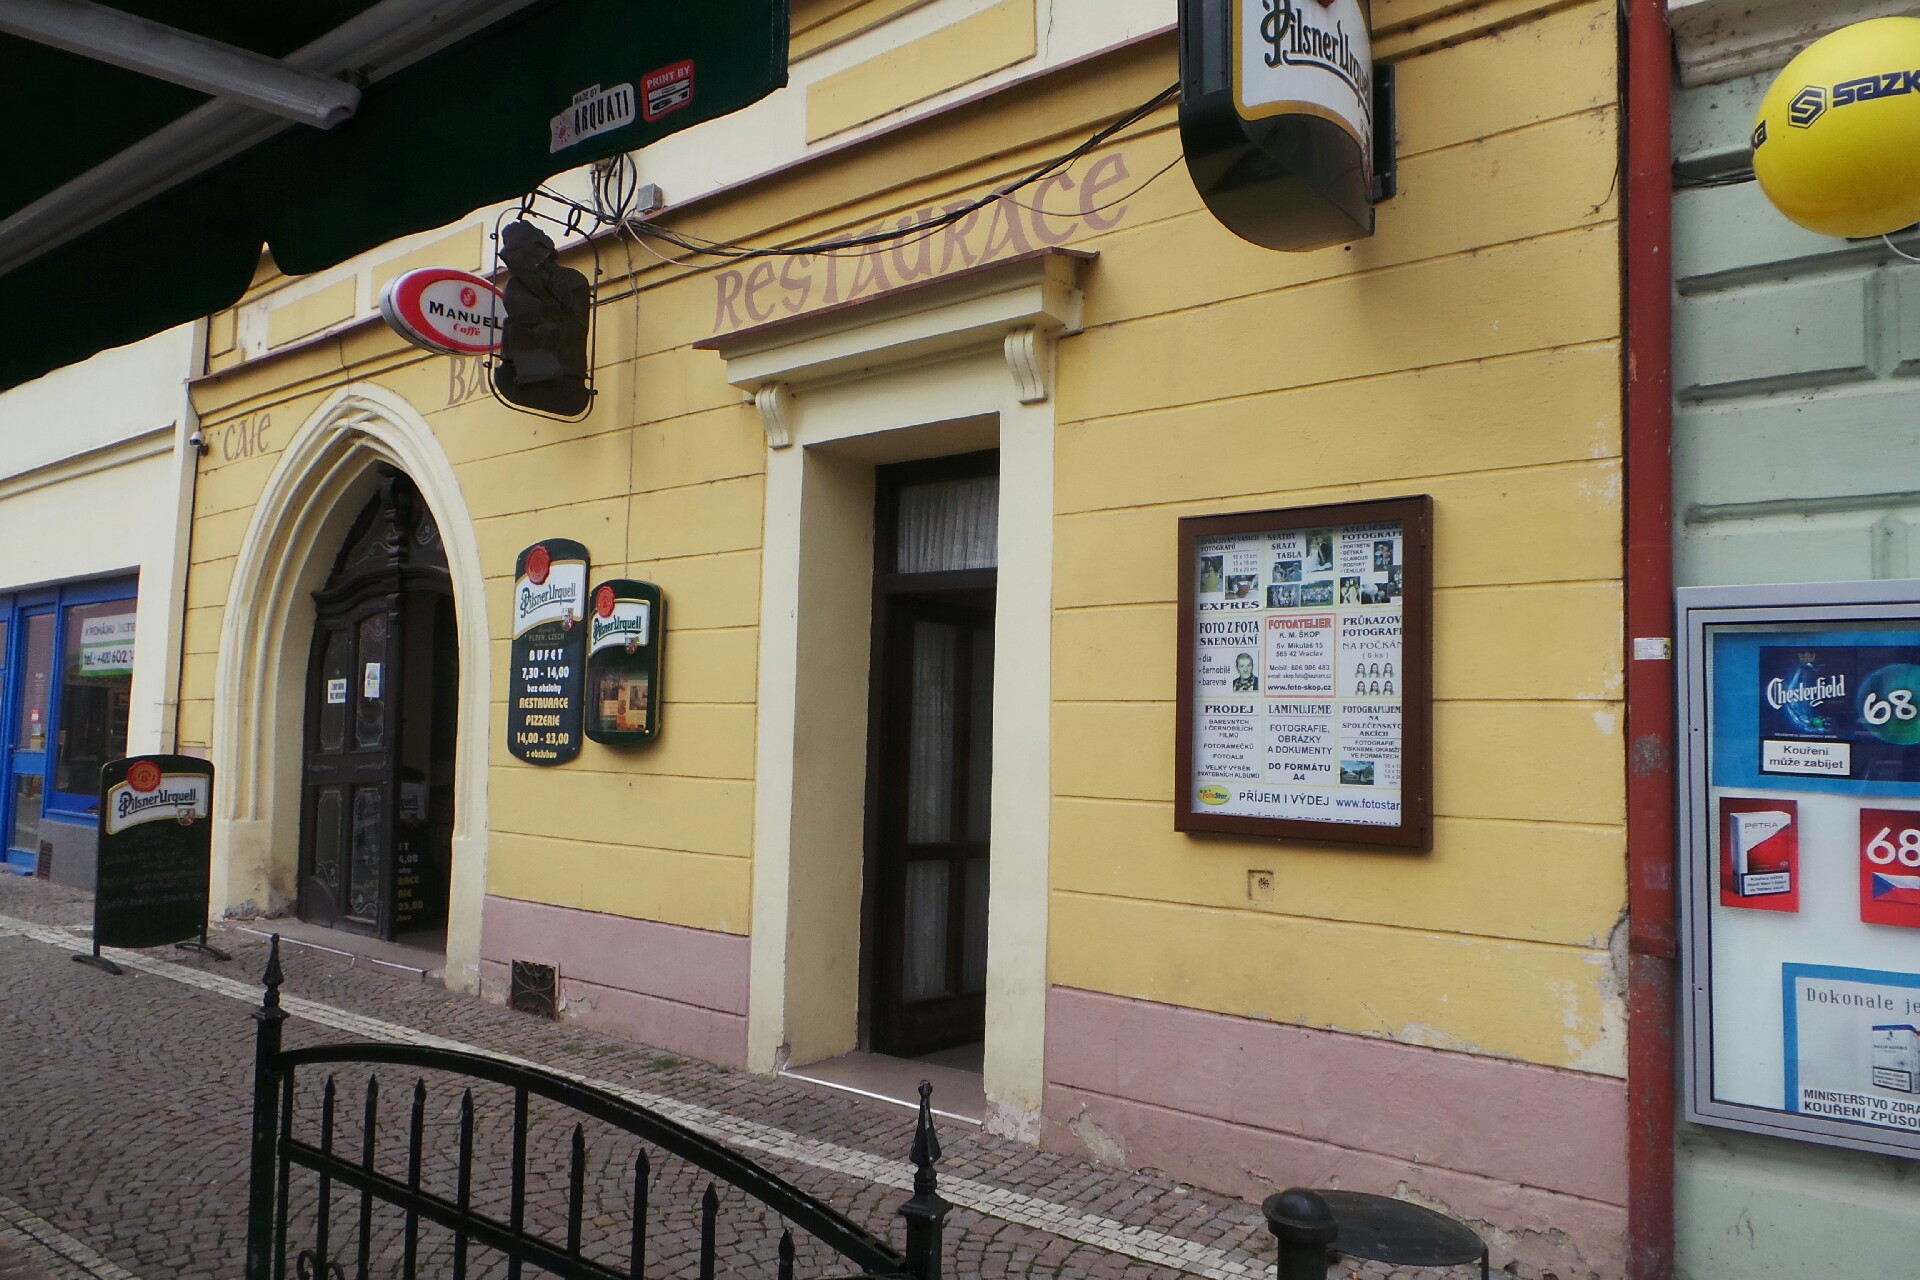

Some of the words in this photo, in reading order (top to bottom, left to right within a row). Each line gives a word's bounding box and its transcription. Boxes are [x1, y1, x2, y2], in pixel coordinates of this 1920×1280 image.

[646, 71, 675, 88] PRINT
[677, 66, 690, 77] BY
[574, 90, 630, 136] ARQUATI
[1271, 542, 1297, 551] SRAZY
[1277, 551, 1302, 559] TABLA
[548, 583, 576, 605] Urquell
[1200, 601, 1260, 611] EXPRES
[613, 615, 642, 634] Urquell
[1268, 618, 1331, 630] FOTOATELIER
[1343, 615, 1401, 625] PRŮKAZOV
[1200, 622, 1225, 634] FOTO
[1227, 622, 1233, 634] Z
[1235, 621, 1260, 633] FOTA
[1343, 628, 1401, 637] FOTOGRAFI
[1200, 634, 1258, 646] SKENOVÁNÍ
[1299, 630, 1320, 638] ŠKOP
[112, 649, 128, 663] 602
[529, 649, 564, 661] BUFET
[1202, 654, 1212, 662] dia
[522, 667, 540, 681] 7,30
[547, 666, 569, 680] 14,00
[1202, 678, 1227, 686] barevné
[1767, 674, 1846, 709] Chesterfield
[519, 697, 568, 709] RESTAURACE
[1205, 705, 1254, 713] PRODEJ
[1268, 704, 1332, 714] LAMINUJEME
[525, 714, 561, 727] PIZZERIE
[1270, 724, 1330, 733] FOTOGRAFIE,
[516, 732, 539, 746] 14,00
[546, 732, 569, 746] 23,00
[1278, 734, 1322, 743] OBRÁZKY
[1275, 746, 1332, 755] DOKUMENTY
[1783, 745, 1829, 756] Kouření
[1268, 762, 1281, 770] DO
[1285, 763, 1331, 772] FORMÁTU
[1769, 757, 1801, 767] může
[118, 790, 160, 818] Pilsner
[158, 788, 197, 807] Urquell
[1239, 790, 1281, 804] PŘÍJEM
[1284, 792, 1287, 804] I
[1291, 793, 1330, 806] VÝDEJ
[1336, 798, 1400, 811] www.fotostar
[1807, 987, 1894, 1010] Dokonale
[1804, 1089, 1888, 1110] MINISTERSTVO
[1804, 1101, 1866, 1118] KOUŘENÍ
[1871, 1110, 1920, 1128] ZPŮSO
